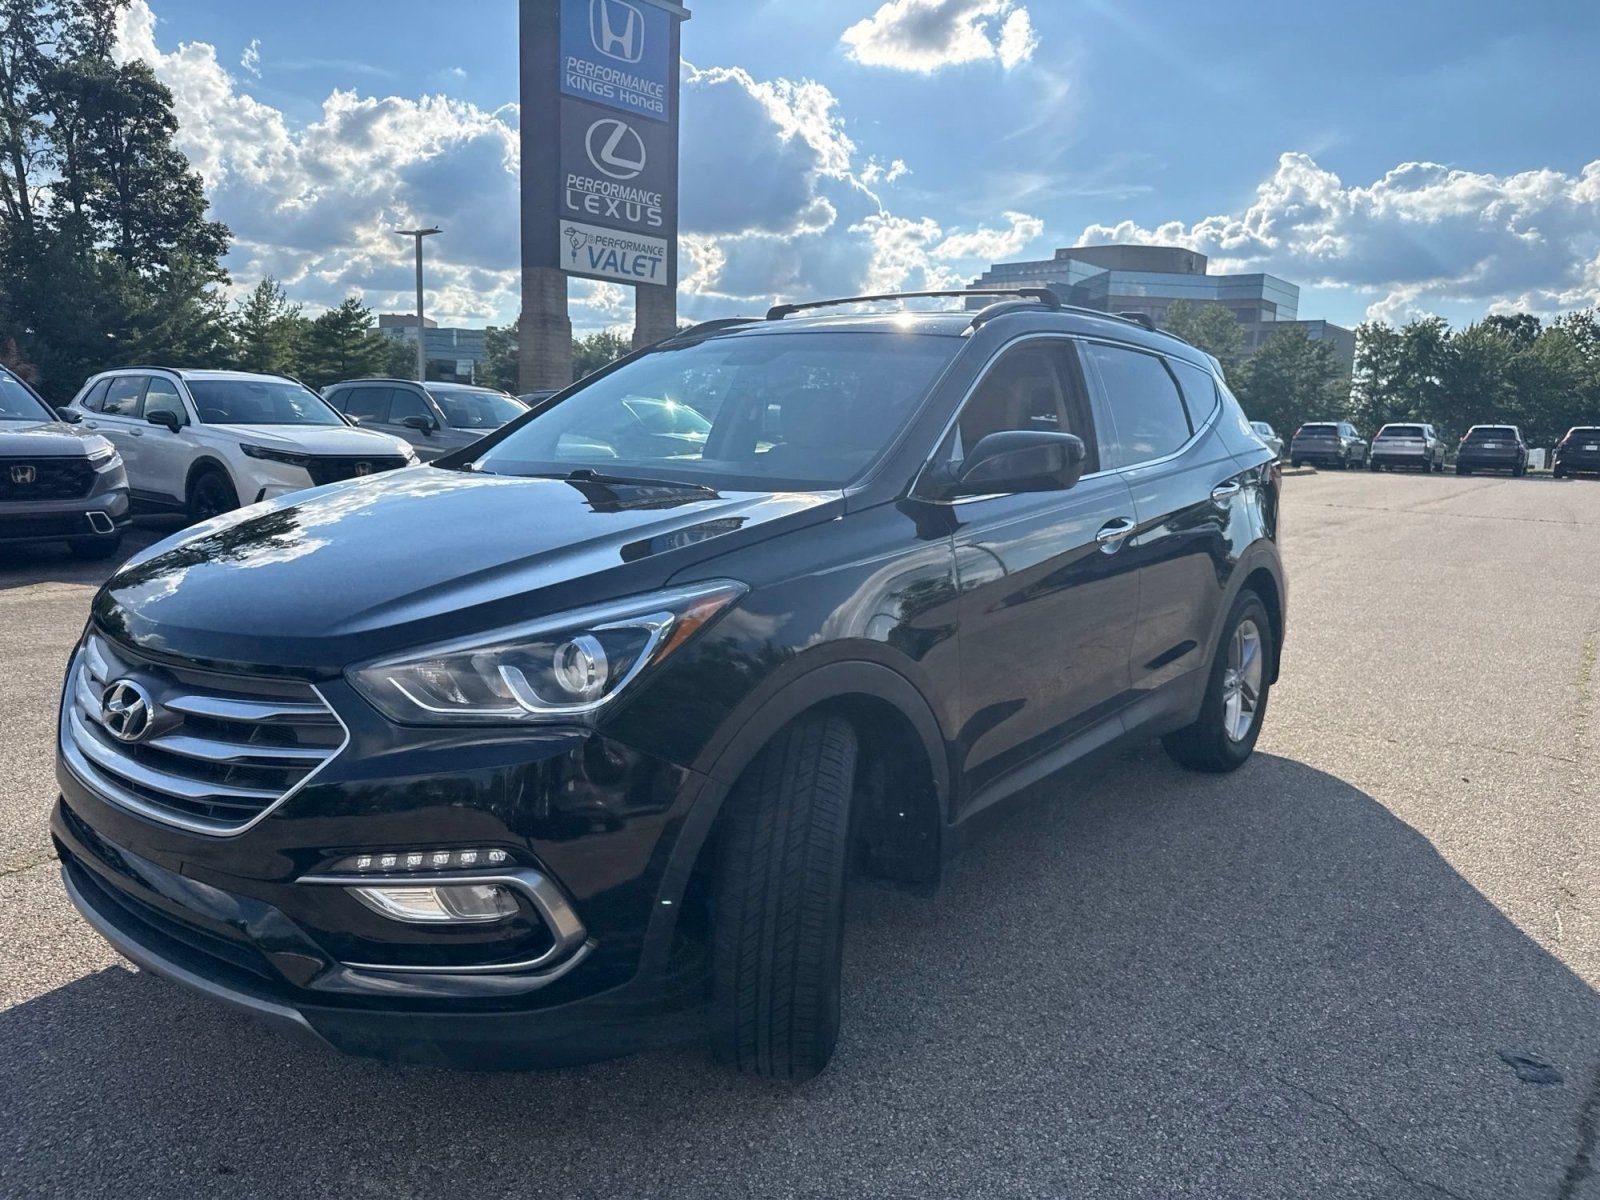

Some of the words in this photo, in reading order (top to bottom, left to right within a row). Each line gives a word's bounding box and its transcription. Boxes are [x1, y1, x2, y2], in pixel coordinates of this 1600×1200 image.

[566, 56, 664, 98] PERFORMANCE
[566, 74, 615, 98] KINGS
[619, 89, 664, 113] Honda
[566, 173, 662, 206] PERFORMANCE
[566, 189, 662, 227] LEXUS
[587, 245, 662, 278] VALET
[595, 235, 664, 256] PERFORMANCE
